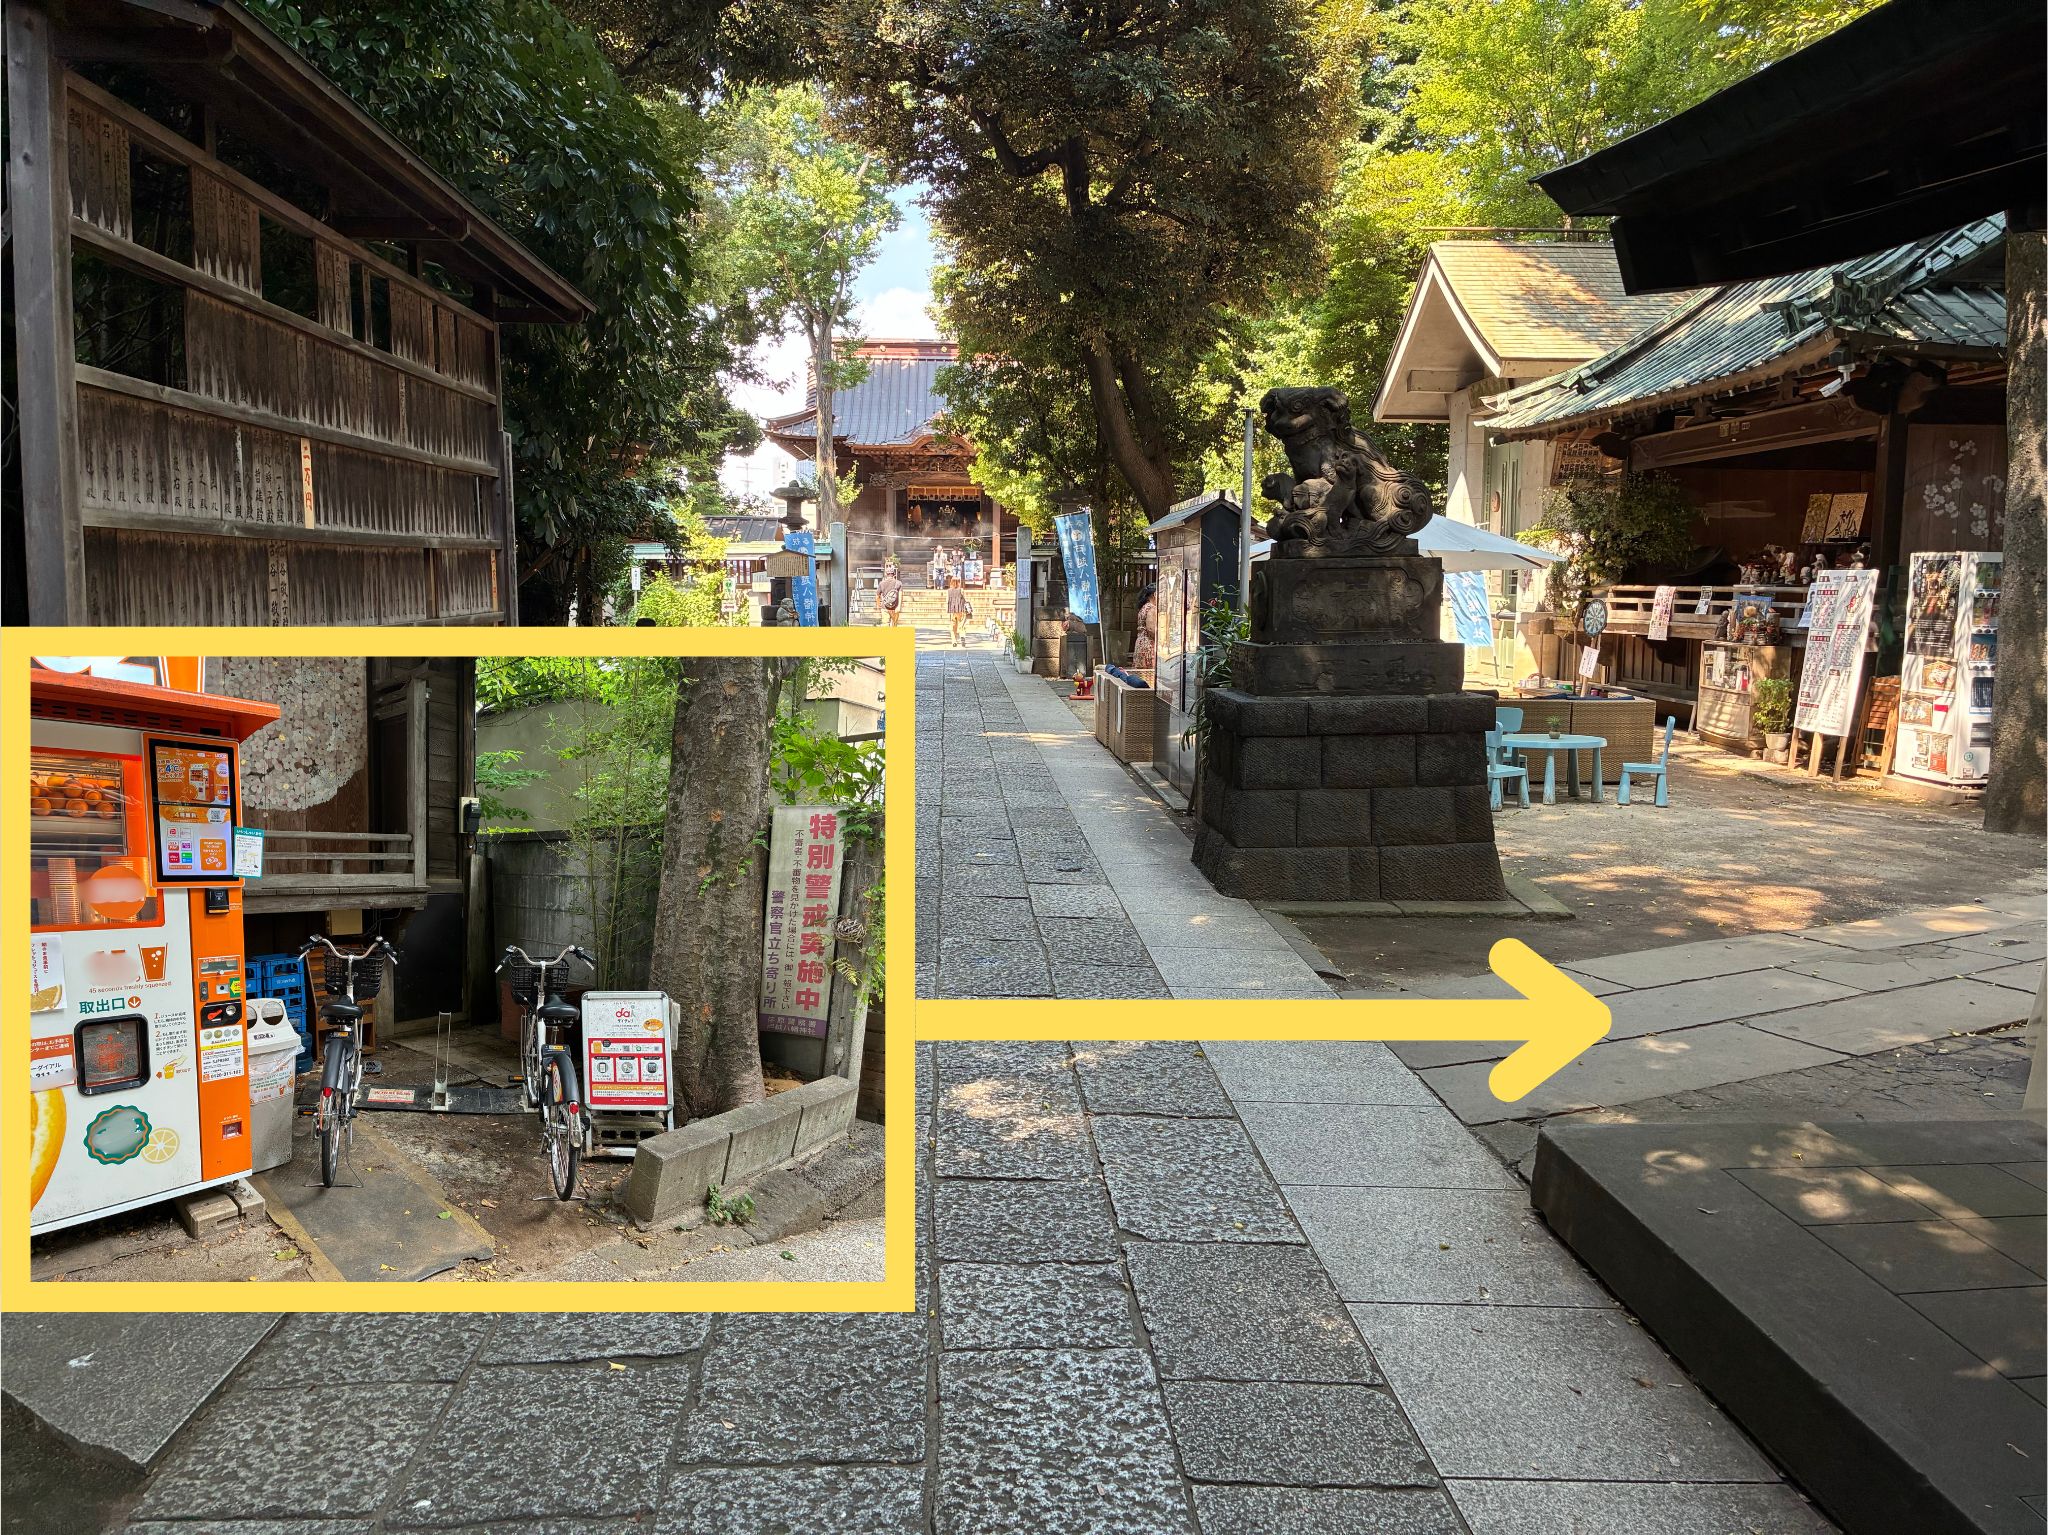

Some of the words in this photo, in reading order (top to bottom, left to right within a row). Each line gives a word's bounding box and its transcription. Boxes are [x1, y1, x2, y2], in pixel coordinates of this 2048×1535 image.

[763, 890, 786, 1009] 警察官立ち寄り所
[795, 813, 837, 1011] 特別警戒実施中
[79, 997, 125, 1014] 取出口
